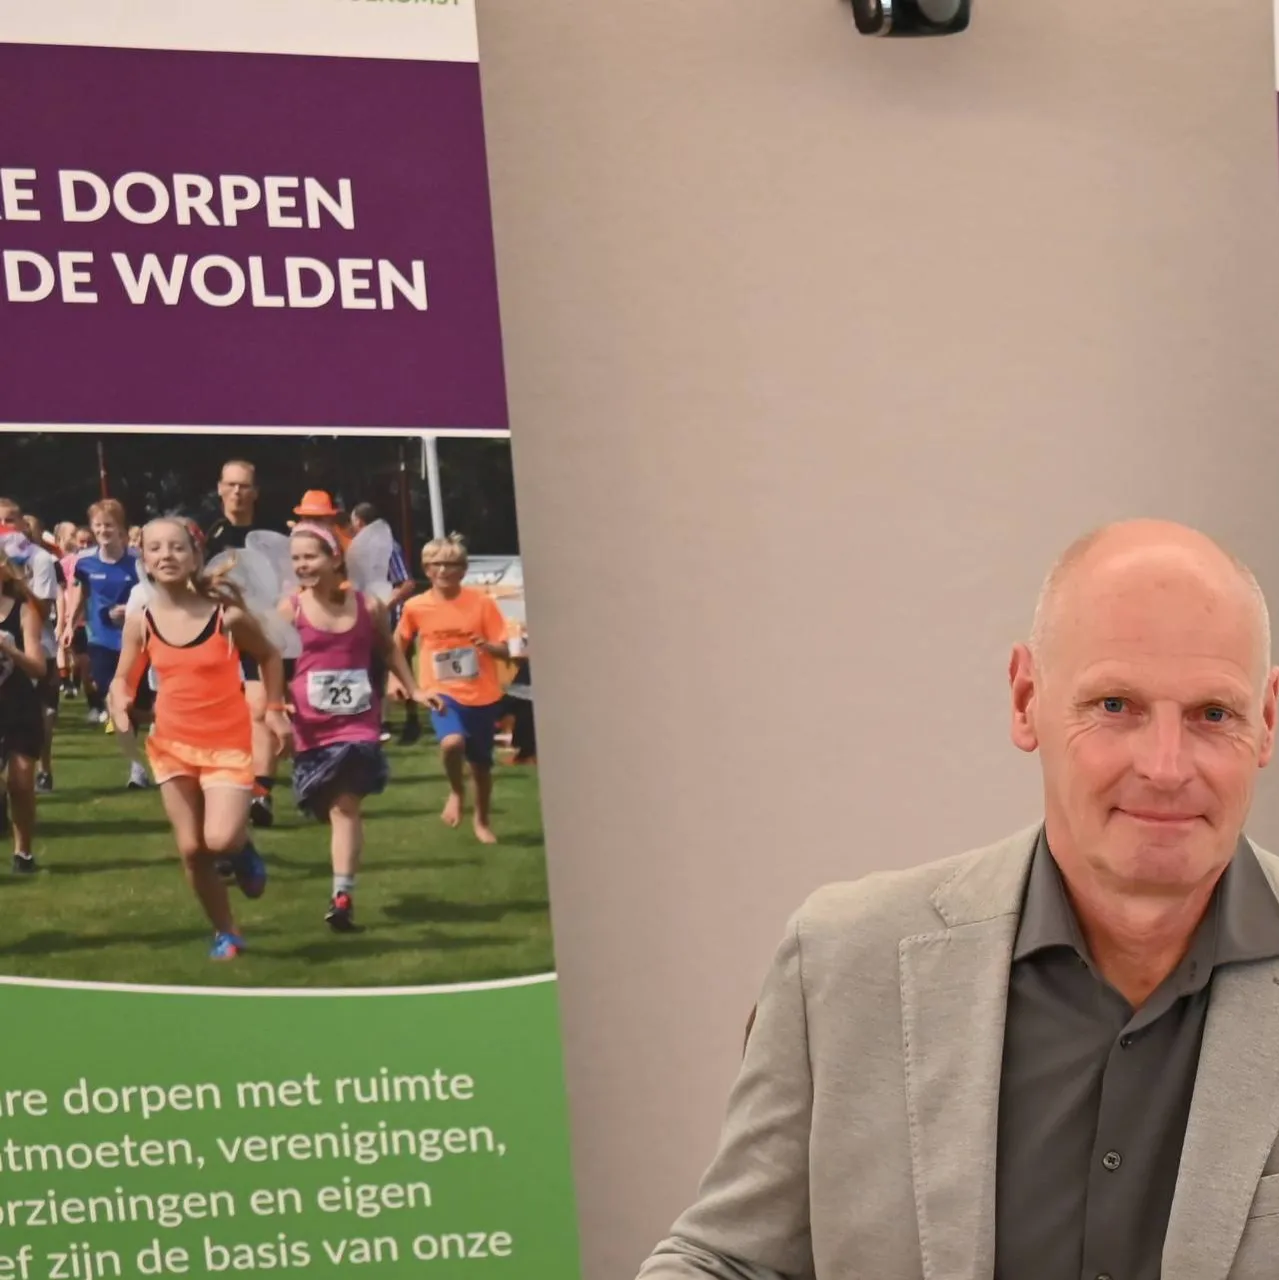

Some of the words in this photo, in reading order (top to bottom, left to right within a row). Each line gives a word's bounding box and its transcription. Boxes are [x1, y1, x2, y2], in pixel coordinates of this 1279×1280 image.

[0, 168, 41, 222] E
[58, 170, 355, 230] DORPEN
[3, 250, 98, 303] DE
[111, 253, 428, 311] WOLDEN
[329, 686, 352, 705] 23
[0, 1087, 48, 1117] re
[63, 1078, 221, 1119] dorpen
[236, 1073, 321, 1109] met
[334, 1068, 475, 1104] ruimte
[0, 1136, 205, 1172] tmoeten,
[216, 1122, 507, 1165] verenigingen,
[250, 1186, 302, 1214] en
[316, 1176, 432, 1218] eigen
[136, 1239, 189, 1275] de
[204, 1233, 311, 1272] basis
[322, 1233, 399, 1266] van
[412, 1229, 513, 1261] onze
